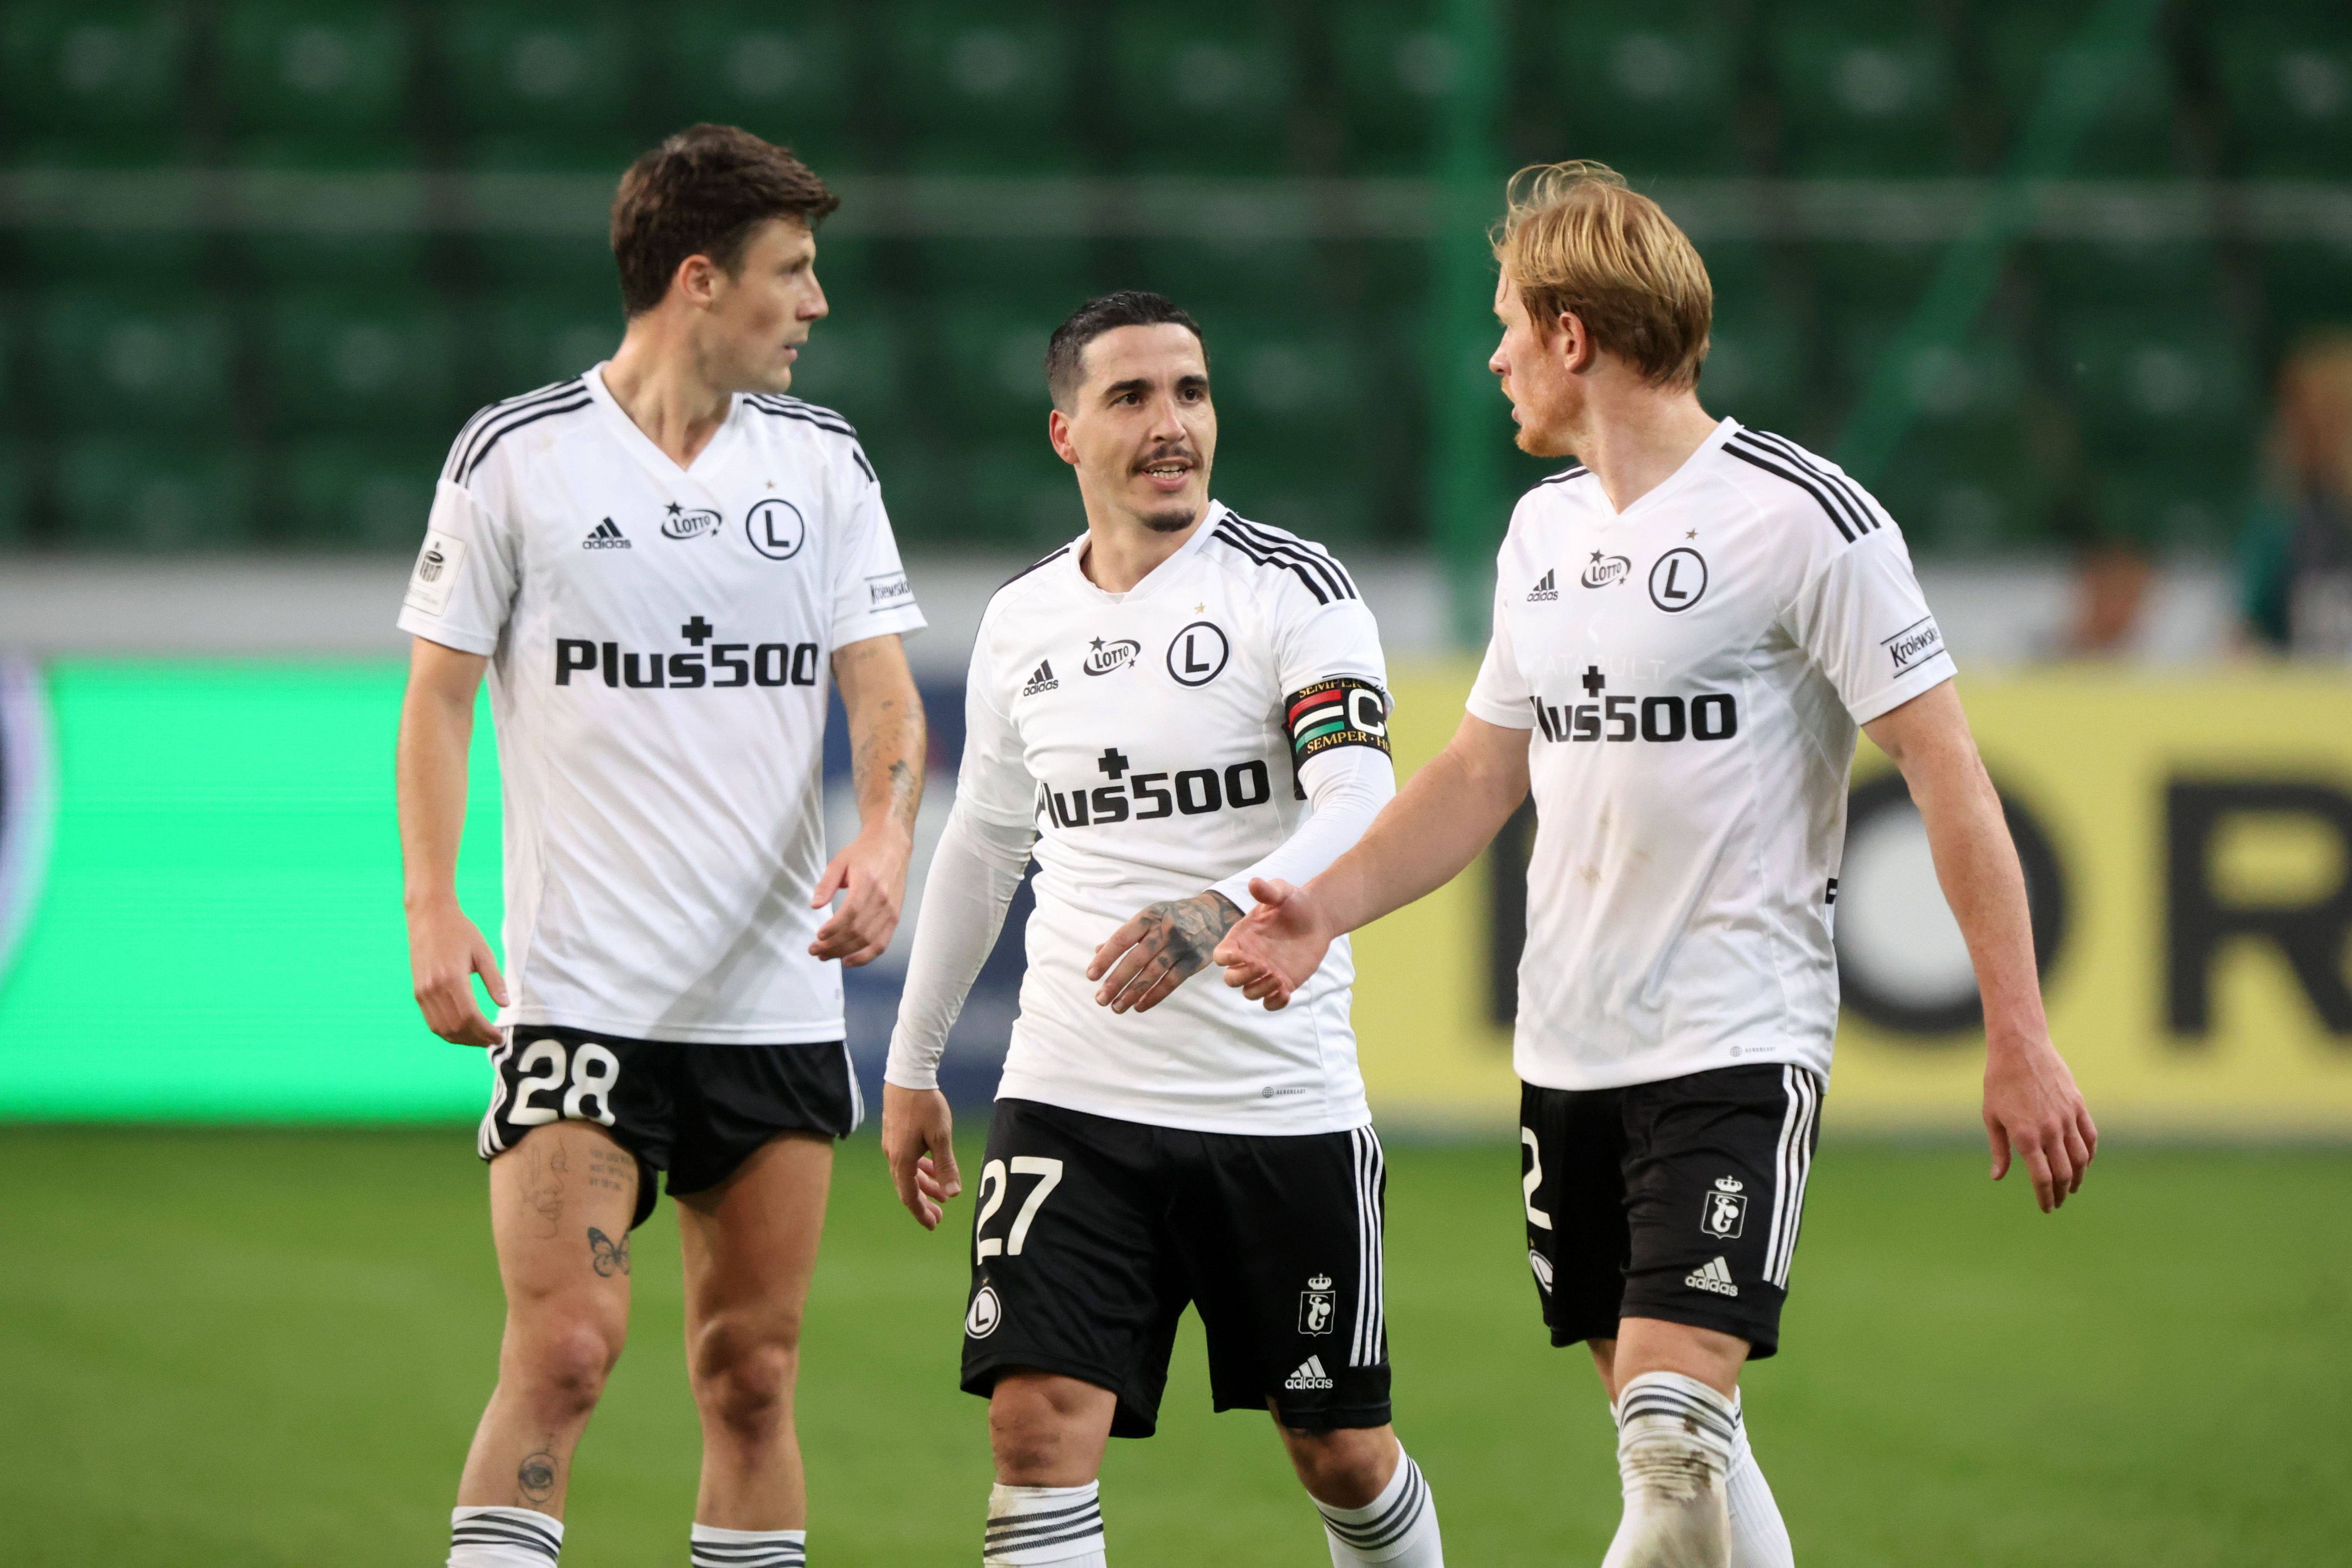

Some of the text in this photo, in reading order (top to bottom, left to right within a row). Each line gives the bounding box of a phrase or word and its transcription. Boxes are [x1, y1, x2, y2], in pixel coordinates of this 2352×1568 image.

[673, 516, 710, 533] LOTTO
[765, 510, 790, 547] L
[583, 539, 632, 550] adidas
[1592, 563, 1622, 581] LOTTO
[1663, 559, 1688, 599] L
[1526, 591, 1559, 602] adidas
[555, 638, 818, 688] Plus500
[1095, 646, 1129, 669] LOTTO
[1184, 635, 1210, 673] L
[1023, 679, 1059, 697] adidas
[1348, 688, 1385, 737] C
[1529, 693, 1738, 743] lus500
[1307, 731, 1368, 754] SEMPER
[507, 1038, 620, 1126] 28
[977, 1156, 1064, 1265] 27
[1685, 1275, 1738, 1297] adidas
[1285, 1376, 1333, 1390] adidas
